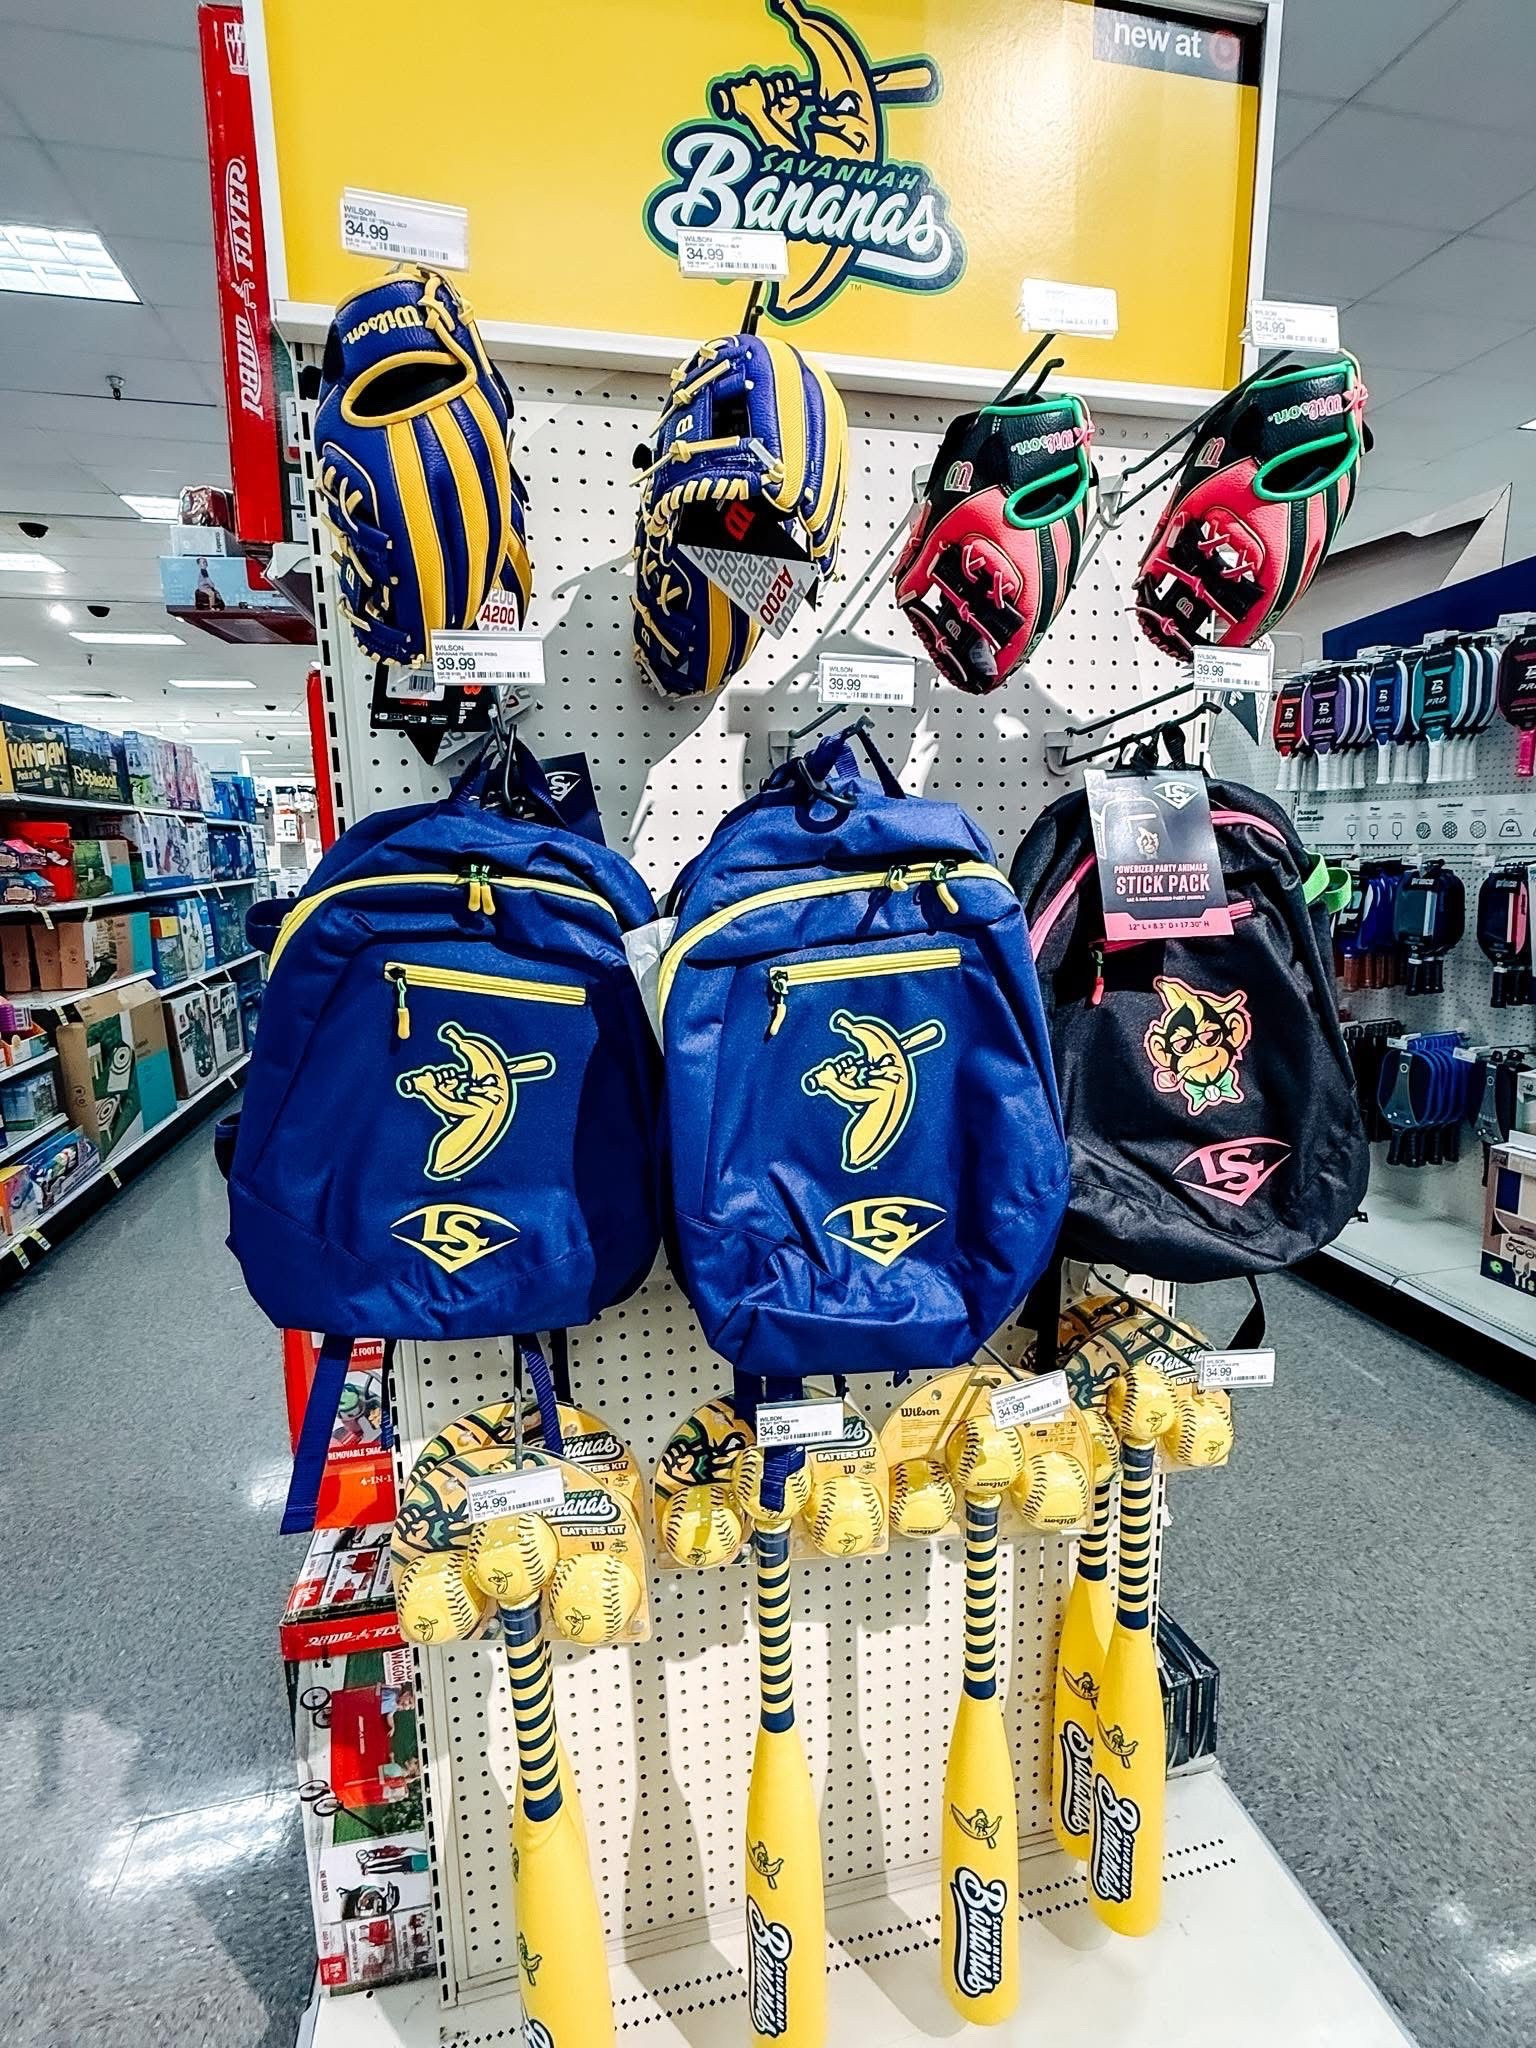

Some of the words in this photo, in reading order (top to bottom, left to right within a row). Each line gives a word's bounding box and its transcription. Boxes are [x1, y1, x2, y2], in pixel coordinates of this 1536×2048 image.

[1115, 21, 1170, 52] new
[1175, 30, 1202, 58] at
[759, 152, 920, 190] SAVANNAH
[344, 205, 376, 217] WILSON
[654, 132, 952, 276] Bananas
[227, 158, 253, 273] FLYER
[345, 220, 388, 240] 34.99
[686, 248, 724, 261] 34.99
[343, 305, 424, 344] Wilson
[1255, 321, 1286, 334] 34.99
[236, 314, 264, 421] RADIO
[1267, 392, 1343, 425] Wilson
[1012, 427, 1075, 455] Wilson
[760, 564, 794, 625] A200
[480, 604, 514, 625] A200
[437, 657, 476, 670] 39.99
[1196, 664, 1224, 676] 39.99
[829, 678, 861, 690] 39.99
[1425, 696, 1447, 706] PRO
[1314, 717, 1332, 726] PRO
[1114, 864, 1154, 873] POWERIZED
[1155, 864, 1177, 872] PARTY
[1177, 863, 1208, 872] ANIMALS
[1116, 875, 1164, 894] STICK
[1168, 873, 1210, 893] PACK
[359, 1345, 376, 1356] FOOT
[1206, 1367, 1231, 1377] 34.99
[901, 1407, 940, 1417] Wilson
[998, 1402, 1025, 1418] 34.99
[760, 1424, 790, 1436] 34.99
[328, 1447, 366, 1460] REMOVABLE
[817, 1451, 859, 1462] BATTERS
[859, 1448, 876, 1459] KIT
[612, 1462, 628, 1470] KIT
[360, 1474, 393, 1486] 4-IN-1
[474, 1497, 508, 1512] 34.99
[561, 1526, 607, 1536] BATTERS
[607, 1525, 625, 1535] KIT
[391, 1651, 405, 1686] WAGON
[1094, 1774, 1140, 1903] Bananas
[951, 1868, 1006, 1996] Bananas
[991, 1915, 1003, 1983] SAVANNAH
[747, 1896, 792, 2035] Bananas
[774, 1959, 787, 2033] SAVANNAH
